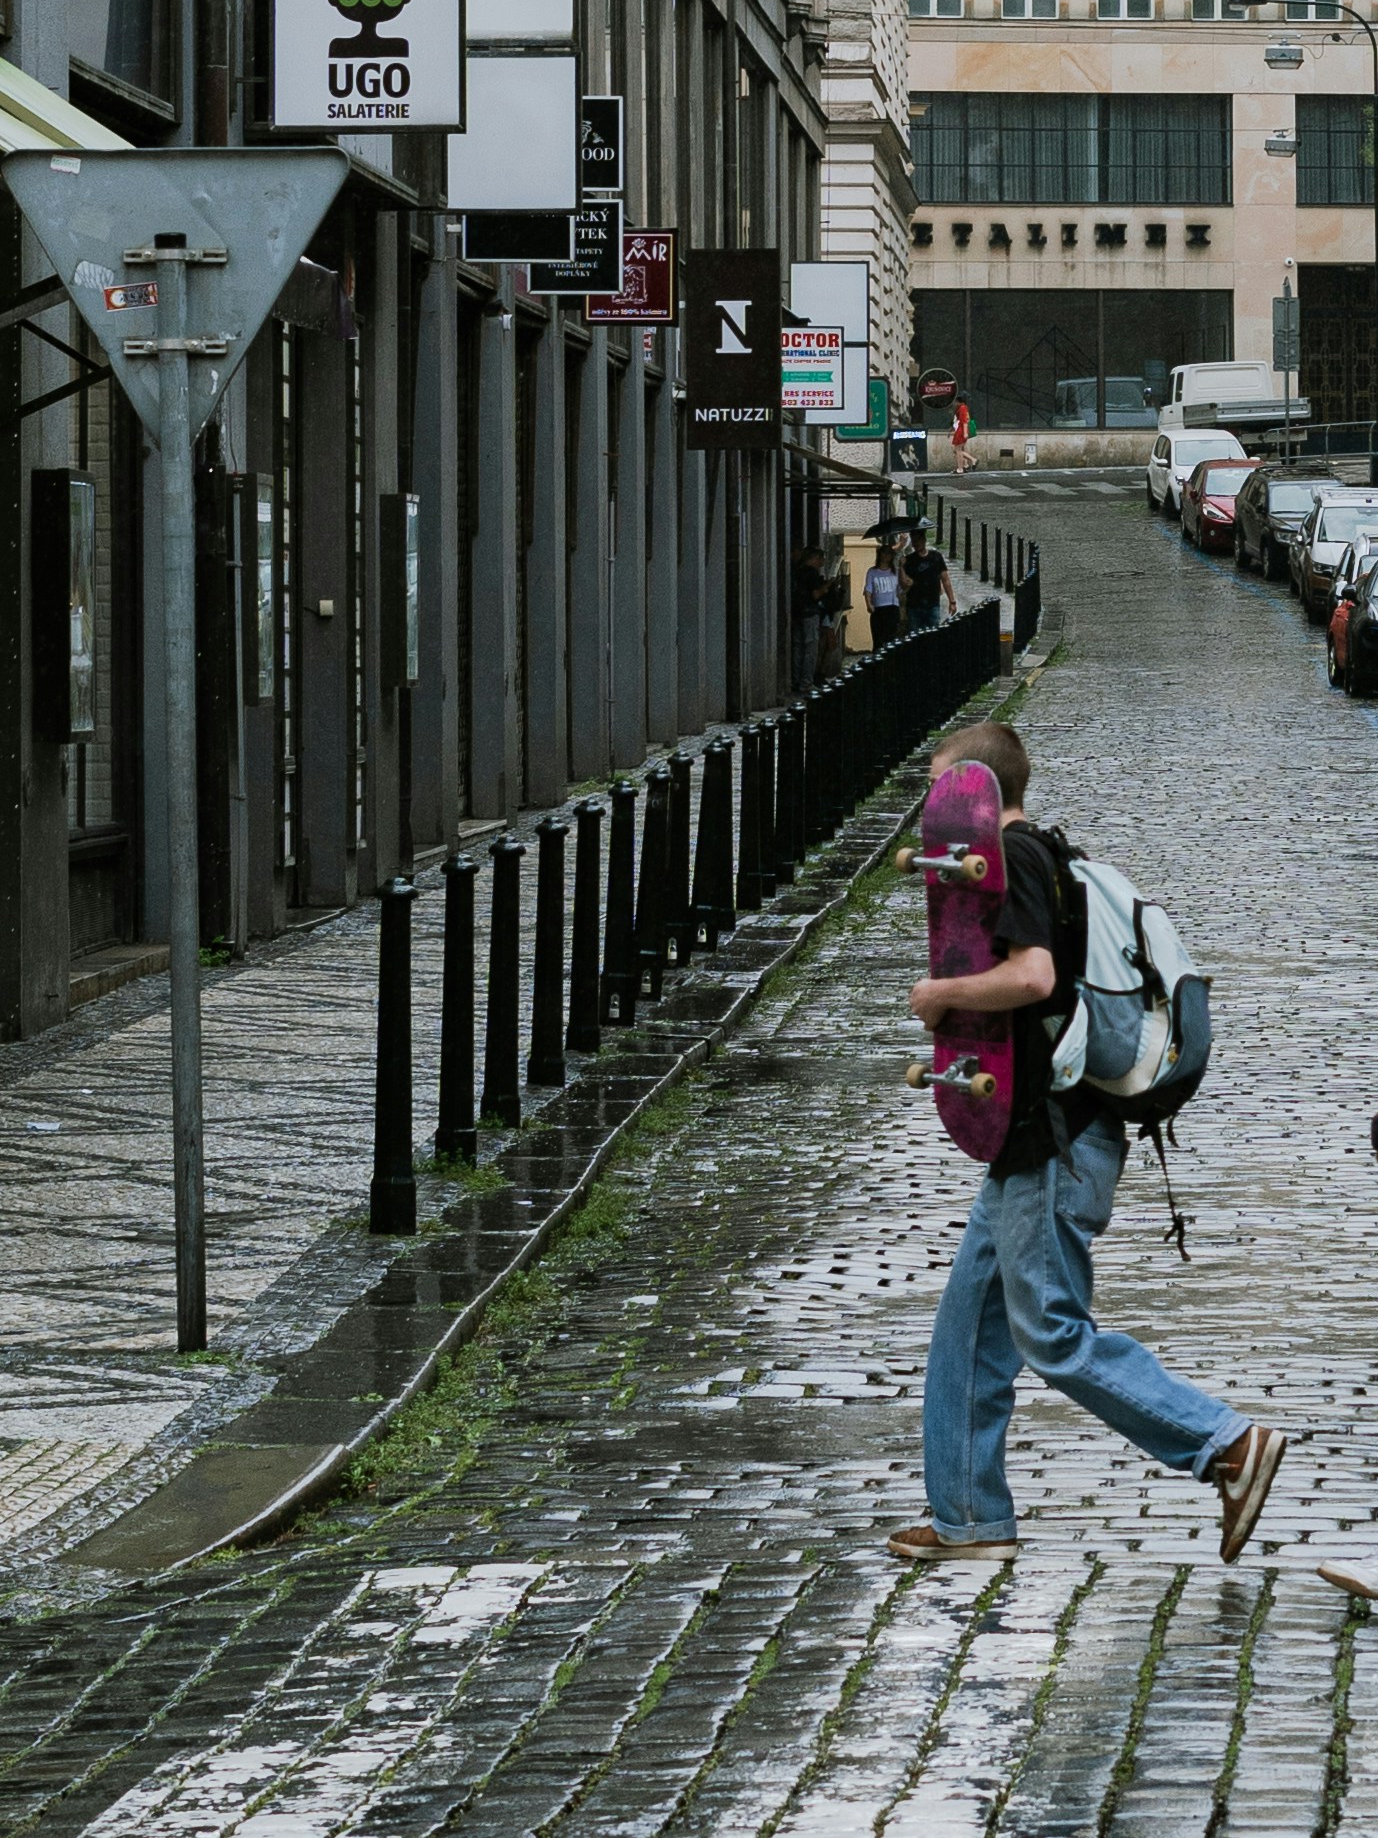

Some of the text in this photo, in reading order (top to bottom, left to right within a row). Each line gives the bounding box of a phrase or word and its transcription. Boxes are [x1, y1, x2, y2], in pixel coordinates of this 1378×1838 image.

[328, 62, 411, 99] UGO
[327, 103, 410, 119] SALATERIE
[581, 147, 615, 161] OOD
[575, 208, 610, 222] ICKÝ
[575, 228, 608, 239] TEK
[910, 223, 1212, 250] ETALIMEX
[624, 240, 668, 262] MÍR
[781, 332, 840, 348] OCTOR
[695, 408, 769, 421] NATUZZI
